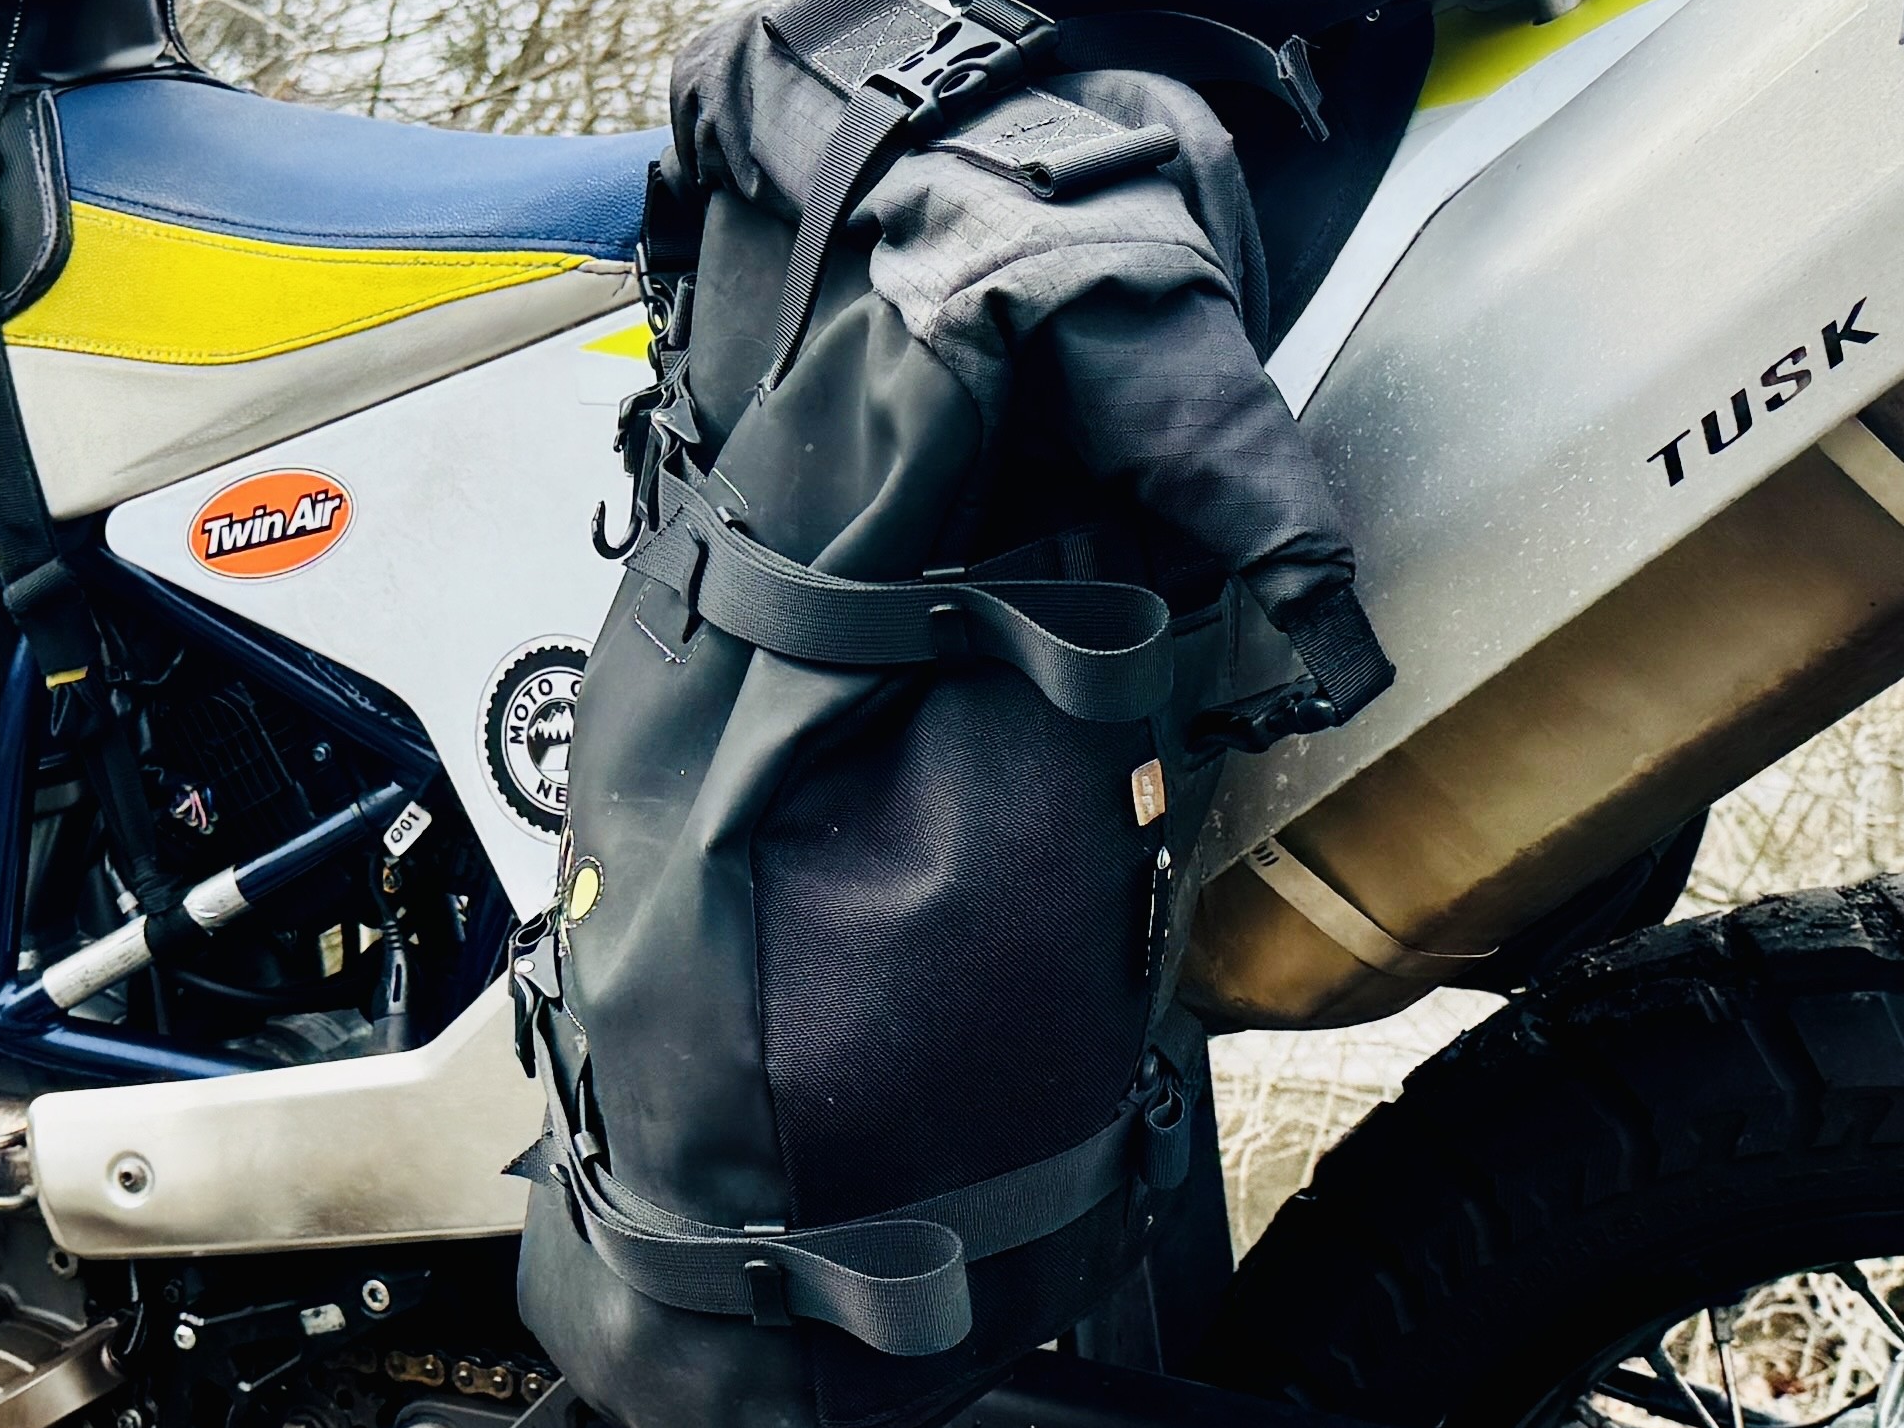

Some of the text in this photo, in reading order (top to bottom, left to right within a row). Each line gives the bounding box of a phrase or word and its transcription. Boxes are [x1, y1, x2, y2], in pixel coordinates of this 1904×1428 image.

[1646, 295, 1880, 488] TUSK
[203, 487, 344, 560] Twin Air
[509, 677, 553, 745] MOTO
[536, 778, 568, 804] NE
